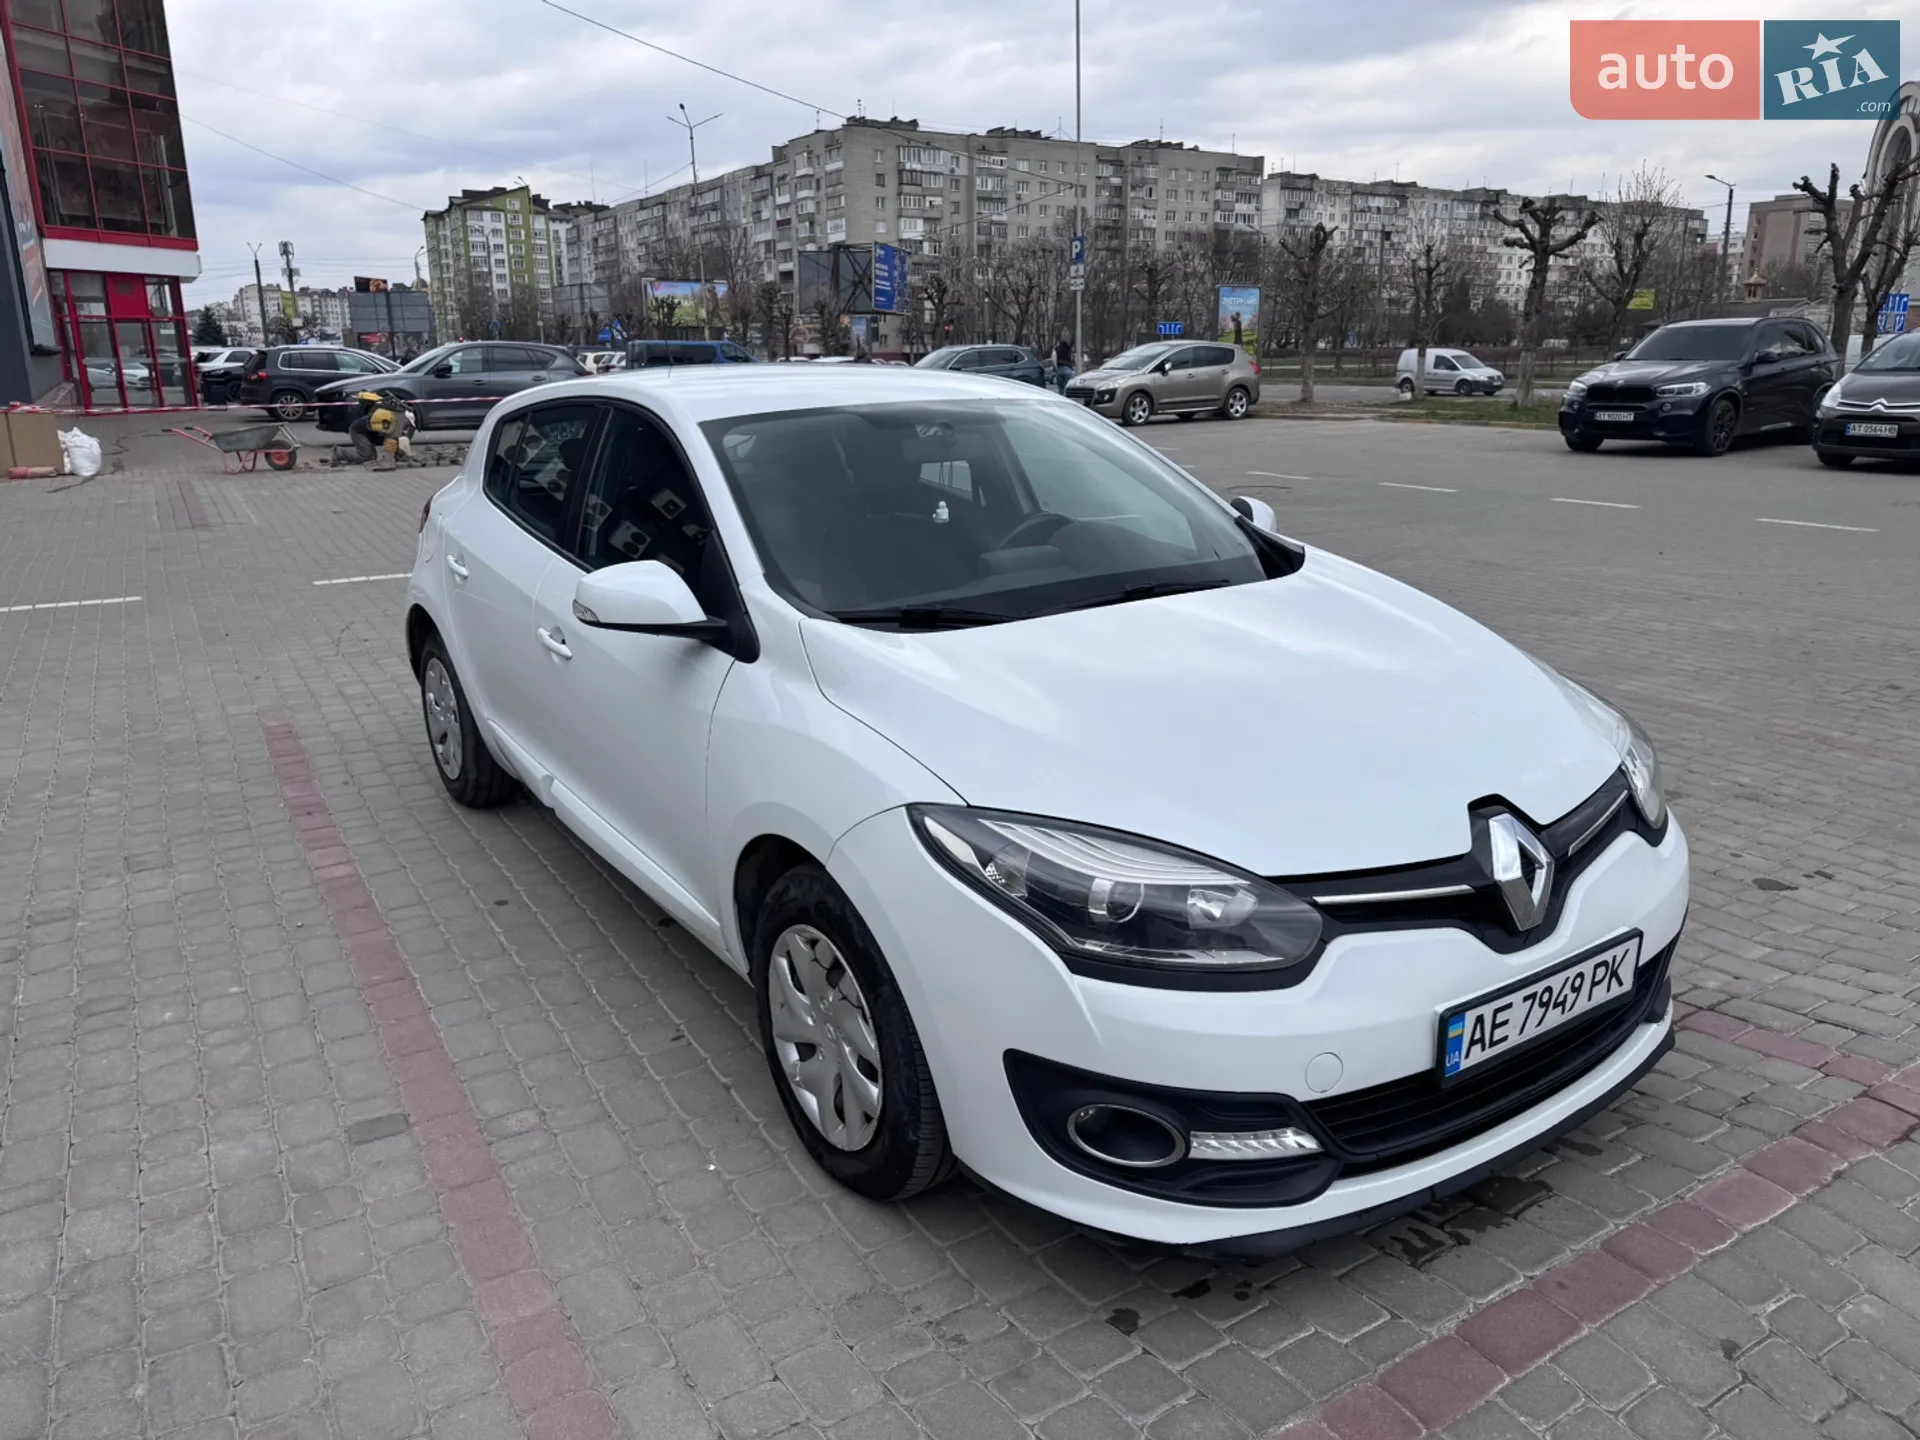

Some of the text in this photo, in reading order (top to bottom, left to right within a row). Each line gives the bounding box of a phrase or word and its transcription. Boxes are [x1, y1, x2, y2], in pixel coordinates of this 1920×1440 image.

[1071, 240, 1081, 259] P
[1851, 424, 1863, 433] AT
[1464, 948, 1630, 1060] AE 7949 PK
[1446, 1050, 1460, 1067] UA
